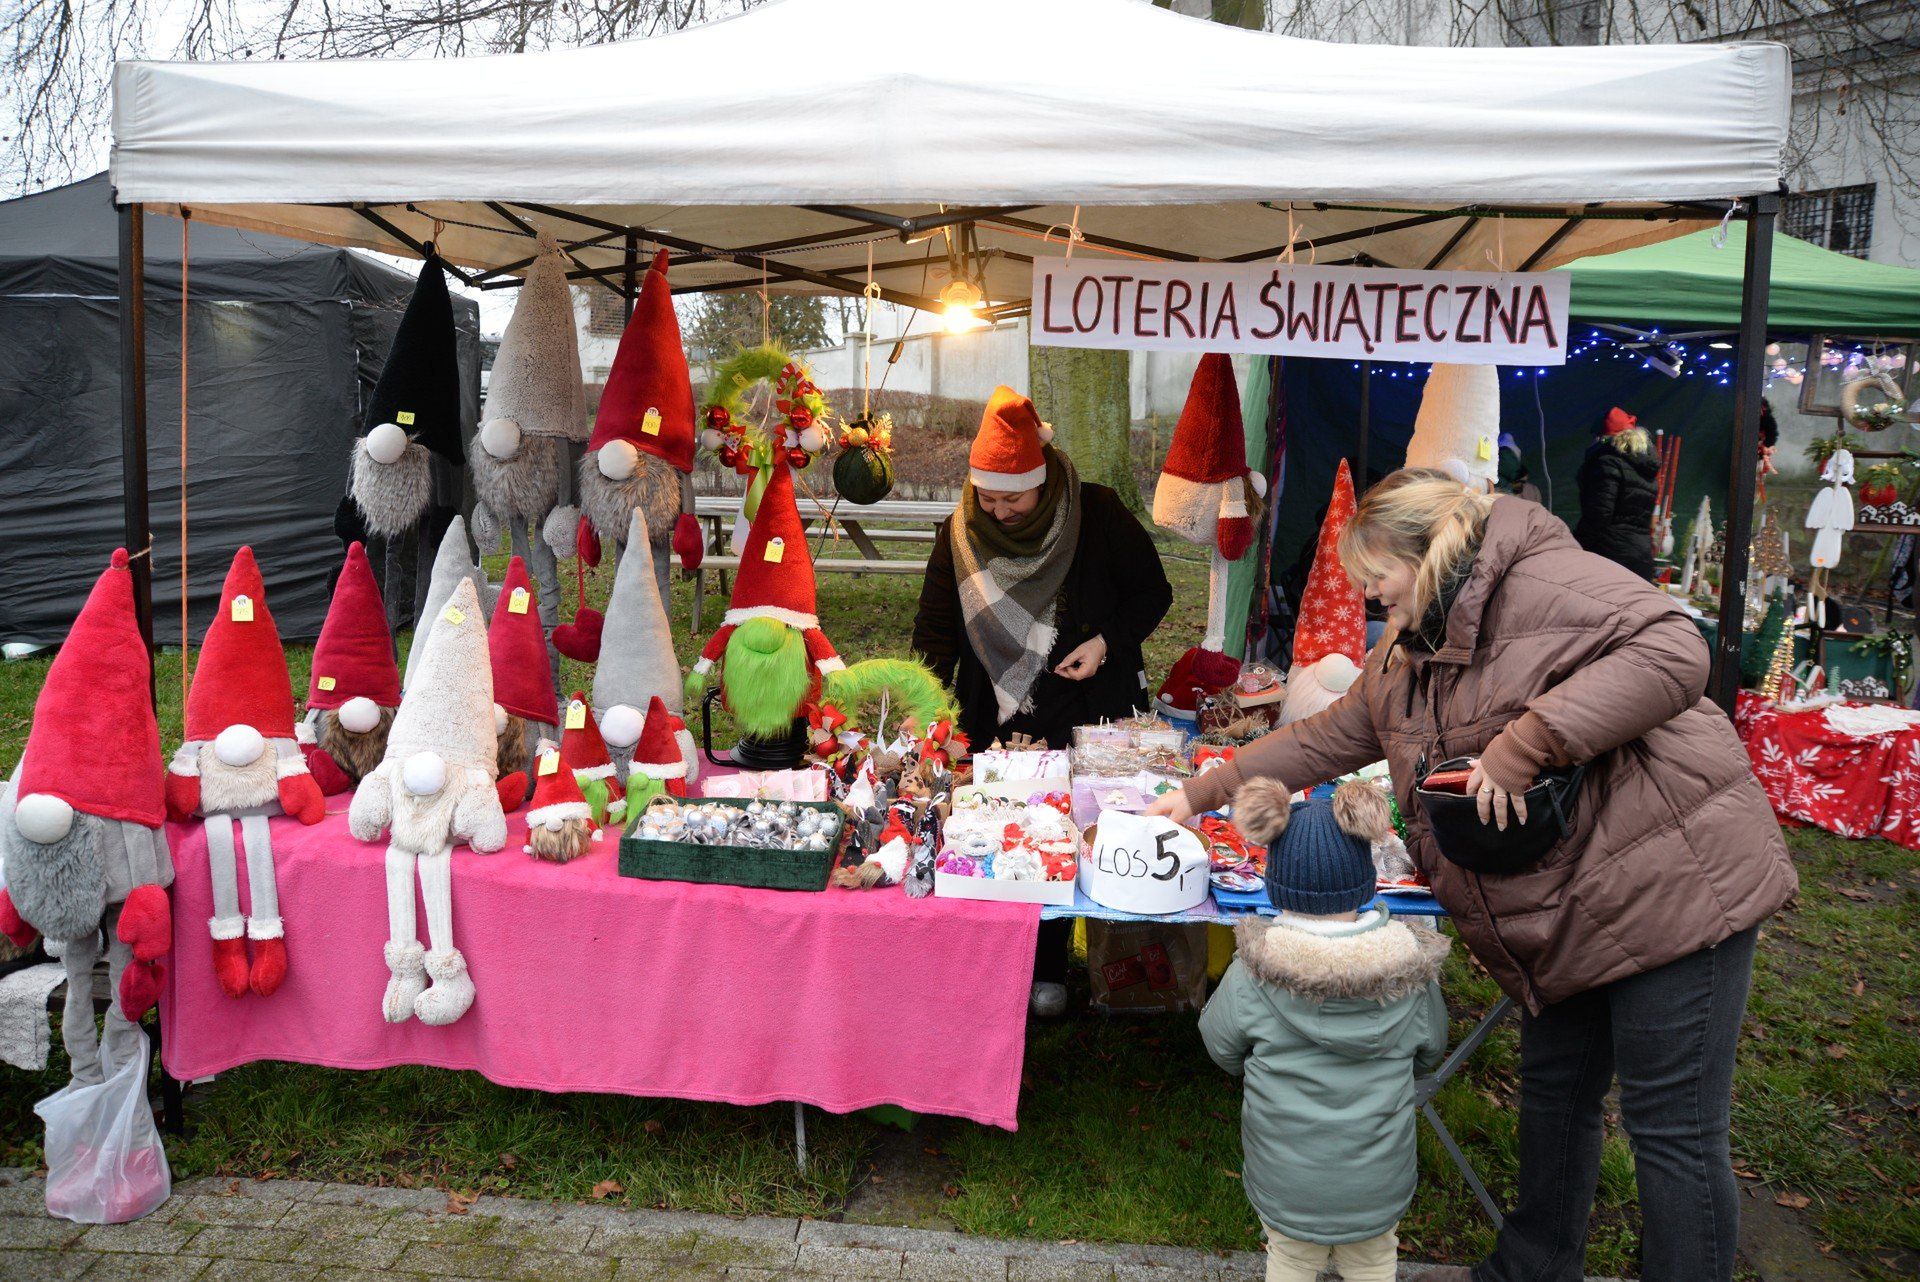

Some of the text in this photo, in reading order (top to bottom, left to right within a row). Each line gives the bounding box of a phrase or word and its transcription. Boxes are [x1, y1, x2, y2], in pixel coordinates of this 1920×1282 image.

[1042, 269, 1559, 355] LOTERIA ŚWIĄTECZNA
[1098, 843, 1148, 878] LOS
